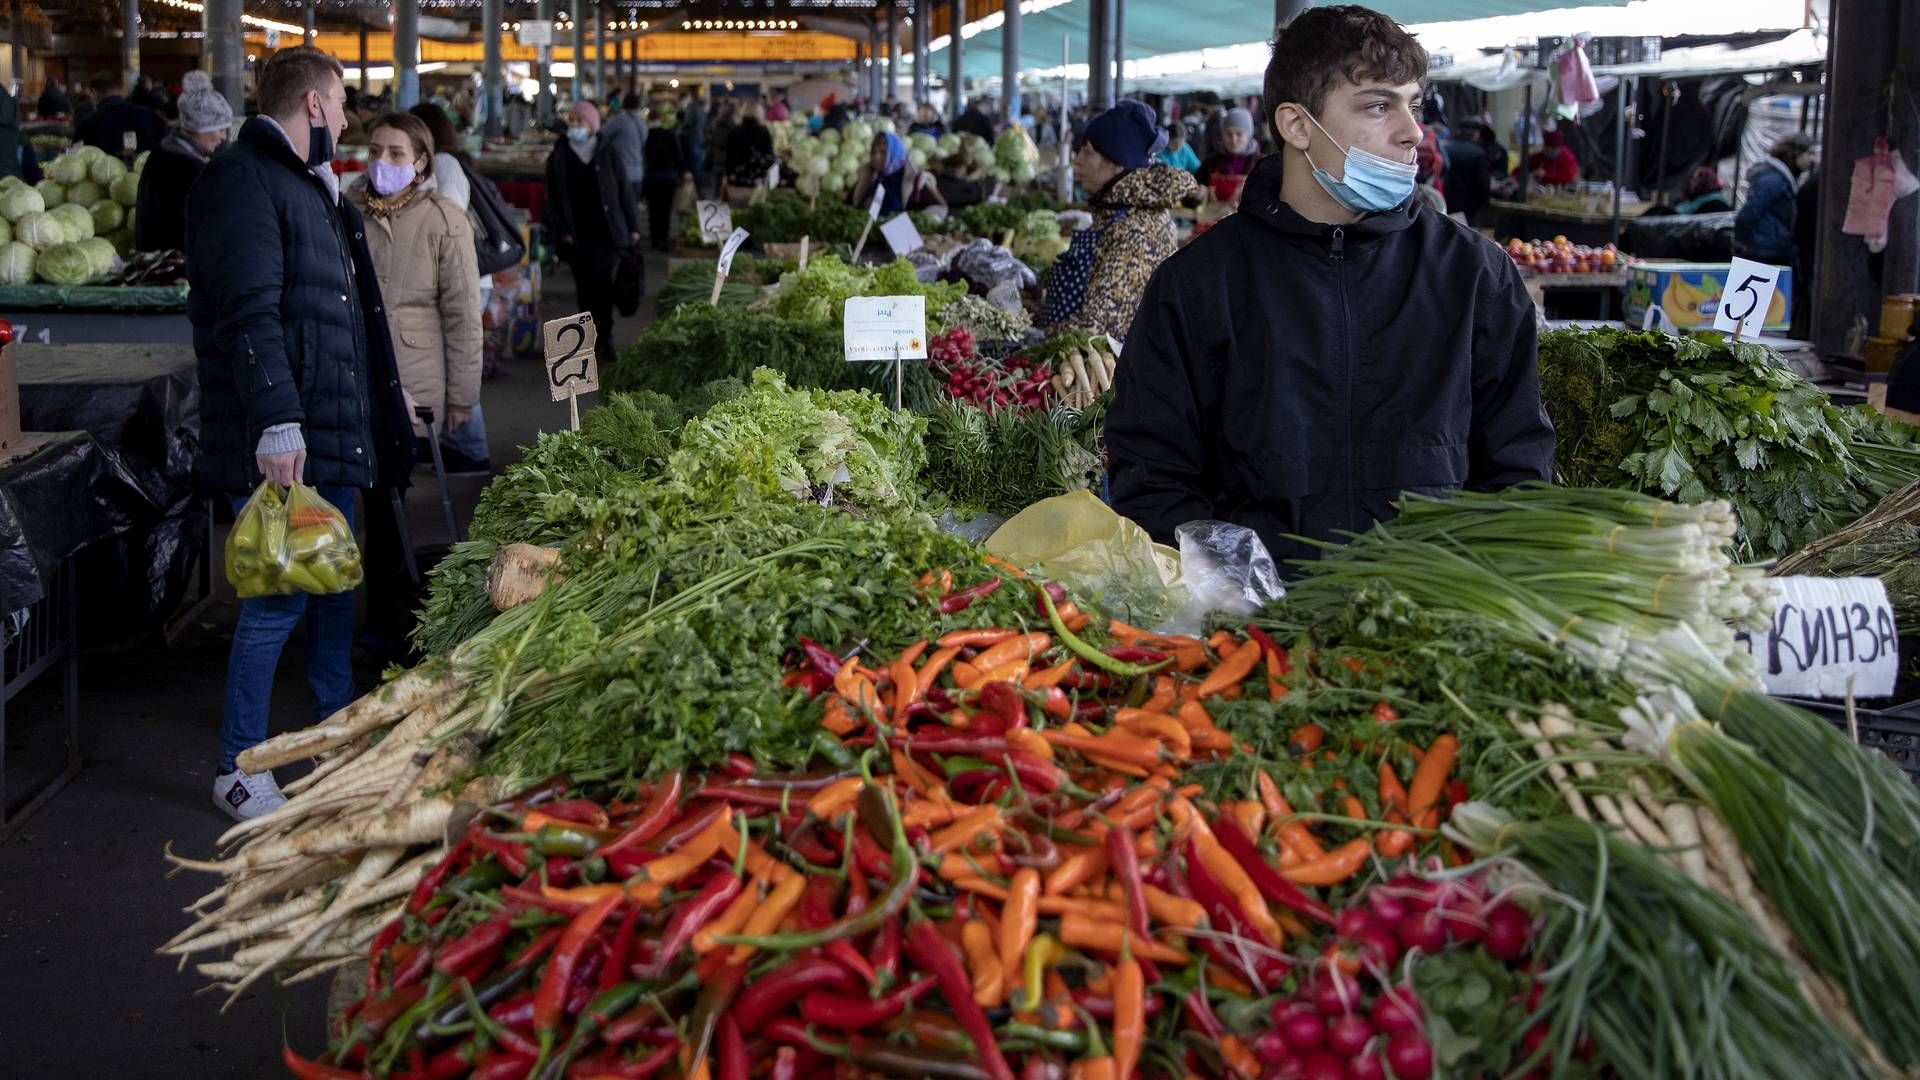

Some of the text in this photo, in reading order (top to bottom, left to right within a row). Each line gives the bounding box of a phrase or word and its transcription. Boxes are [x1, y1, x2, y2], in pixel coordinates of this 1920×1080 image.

[1724, 274, 1771, 321] 5
[552, 324, 588, 386] 2
[1767, 602, 1898, 676] КИНЗА
